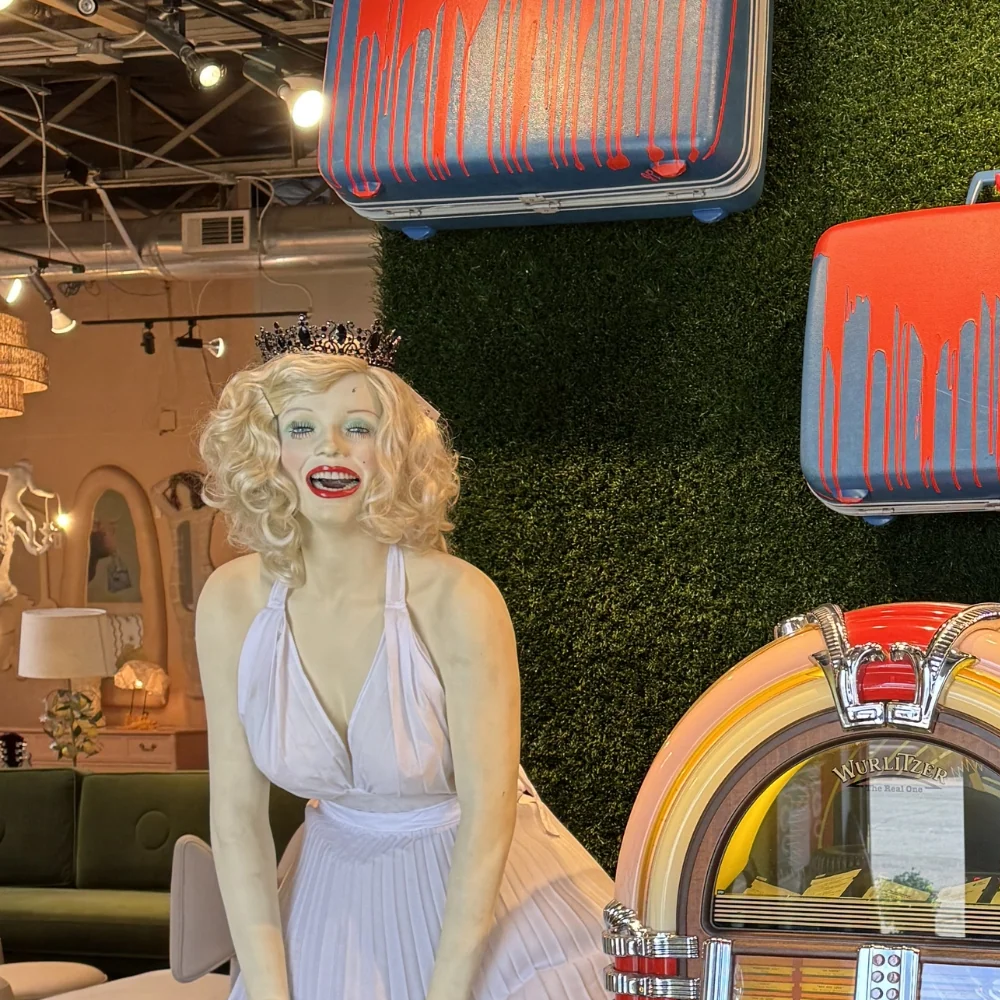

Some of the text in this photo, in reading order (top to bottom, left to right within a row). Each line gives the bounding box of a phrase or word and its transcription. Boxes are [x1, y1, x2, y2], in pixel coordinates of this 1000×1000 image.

[832, 752, 948, 785] WURLITZER
[867, 785, 923, 793] The Real One
